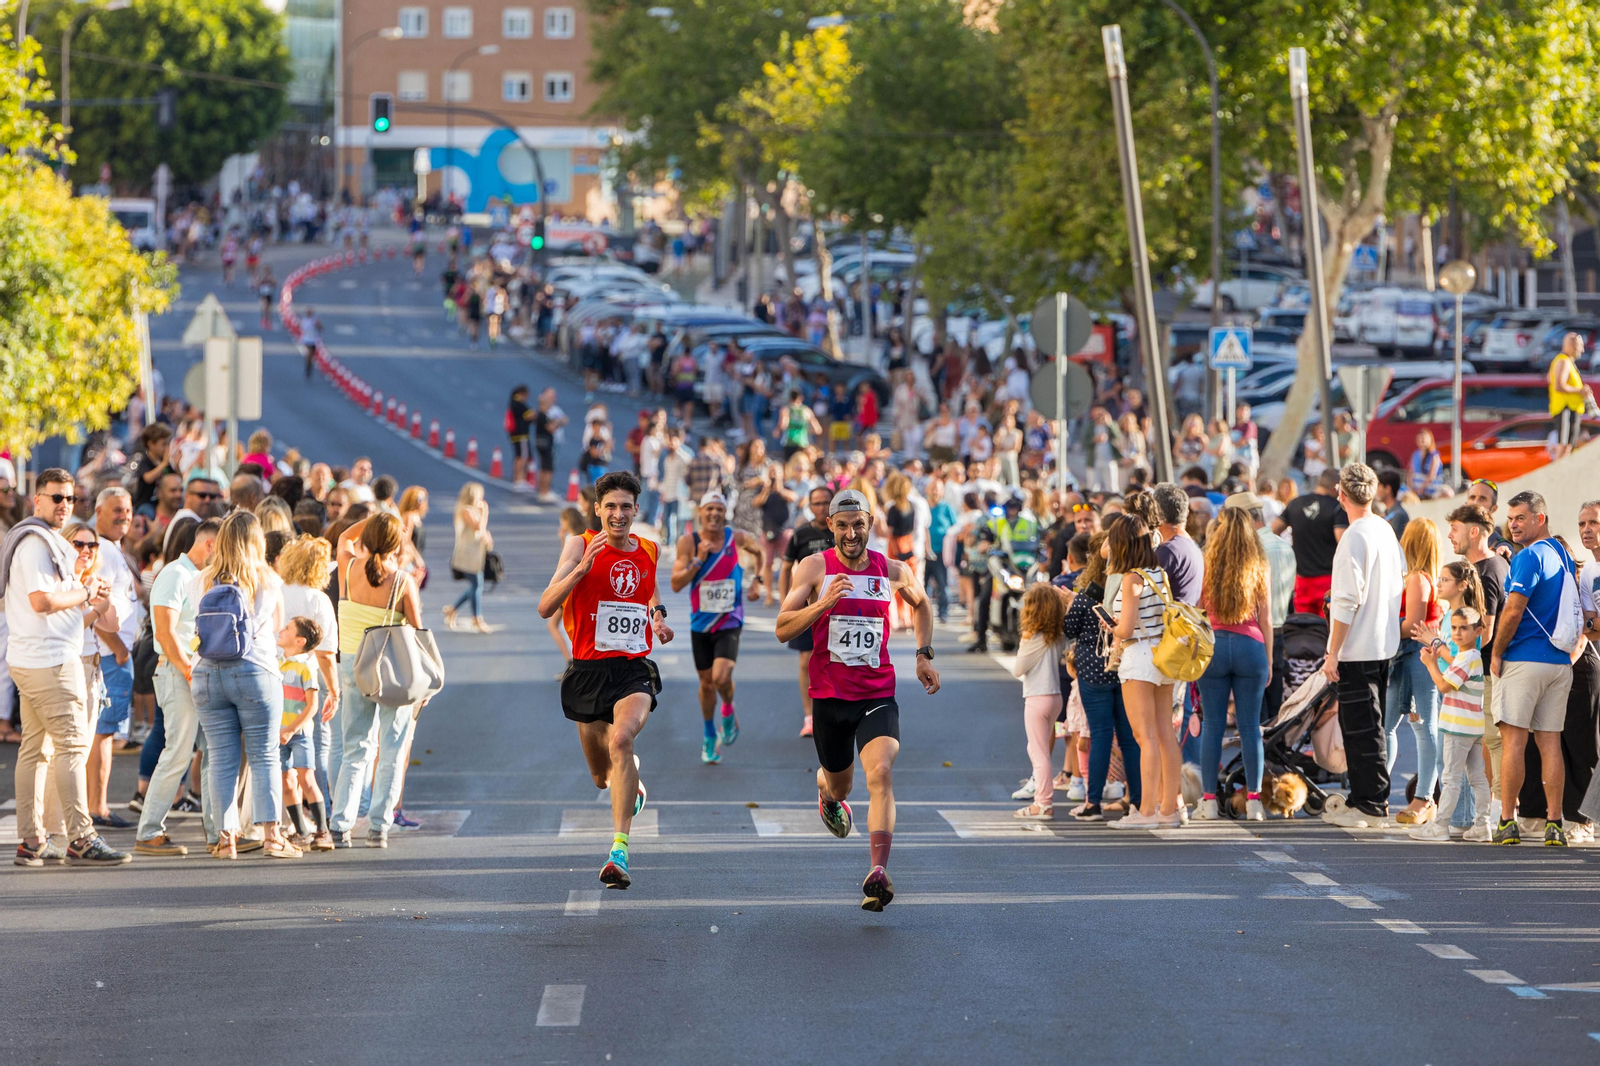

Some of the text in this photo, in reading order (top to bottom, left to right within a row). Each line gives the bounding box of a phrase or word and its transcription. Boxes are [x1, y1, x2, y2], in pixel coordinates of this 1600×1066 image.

[706, 589, 728, 601] 962
[607, 616, 641, 635] 898
[839, 630, 875, 649] 419
